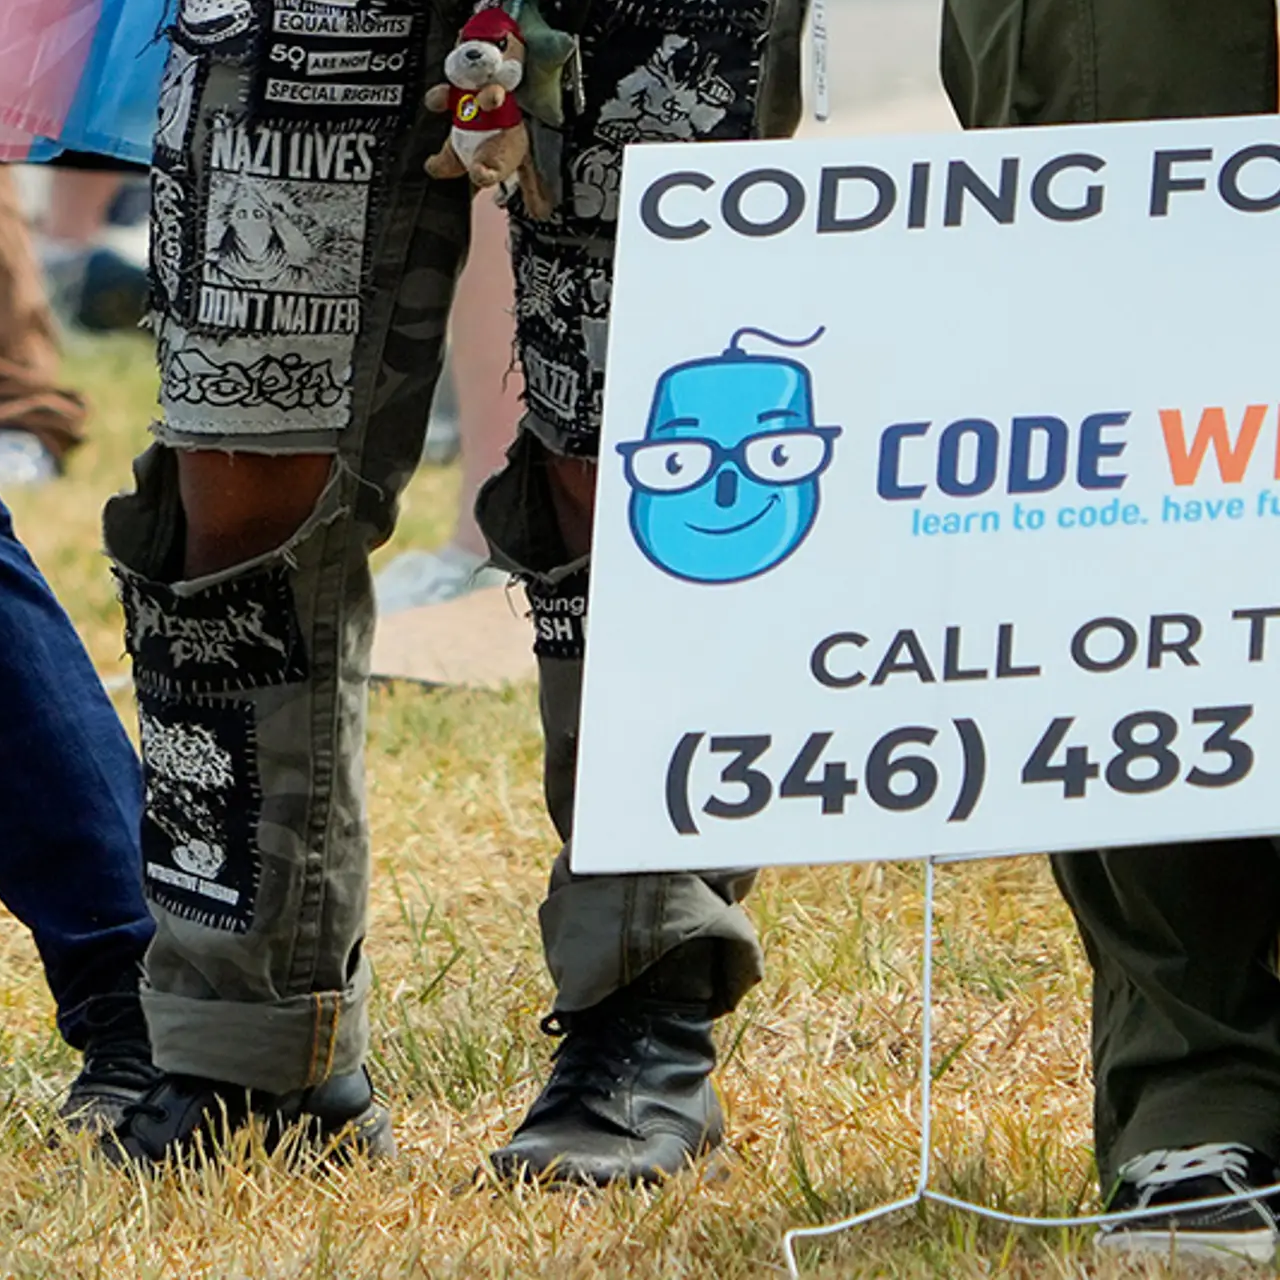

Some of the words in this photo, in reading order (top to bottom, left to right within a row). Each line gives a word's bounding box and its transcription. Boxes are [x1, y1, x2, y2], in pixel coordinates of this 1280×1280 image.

[278, 12, 340, 33] EQUAL
[345, 17, 406, 35] RIGHTS
[269, 81, 338, 102] SPECIAL
[341, 87, 399, 103] RIGHTS
[211, 125, 282, 177] NAZI
[288, 130, 377, 182] LIVES
[640, 152, 1108, 241] CODING
[1148, 143, 1280, 218] FO
[271, 295, 361, 334] MATTER
[875, 410, 1132, 502] CODE
[911, 504, 1000, 538] learn
[1013, 501, 1046, 531] to
[1057, 493, 1148, 528] code.
[1161, 494, 1244, 523] have
[809, 621, 1042, 690] CALL
[1069, 612, 1203, 673] OR
[664, 715, 988, 836] (346)
[1020, 703, 1255, 800] 483
